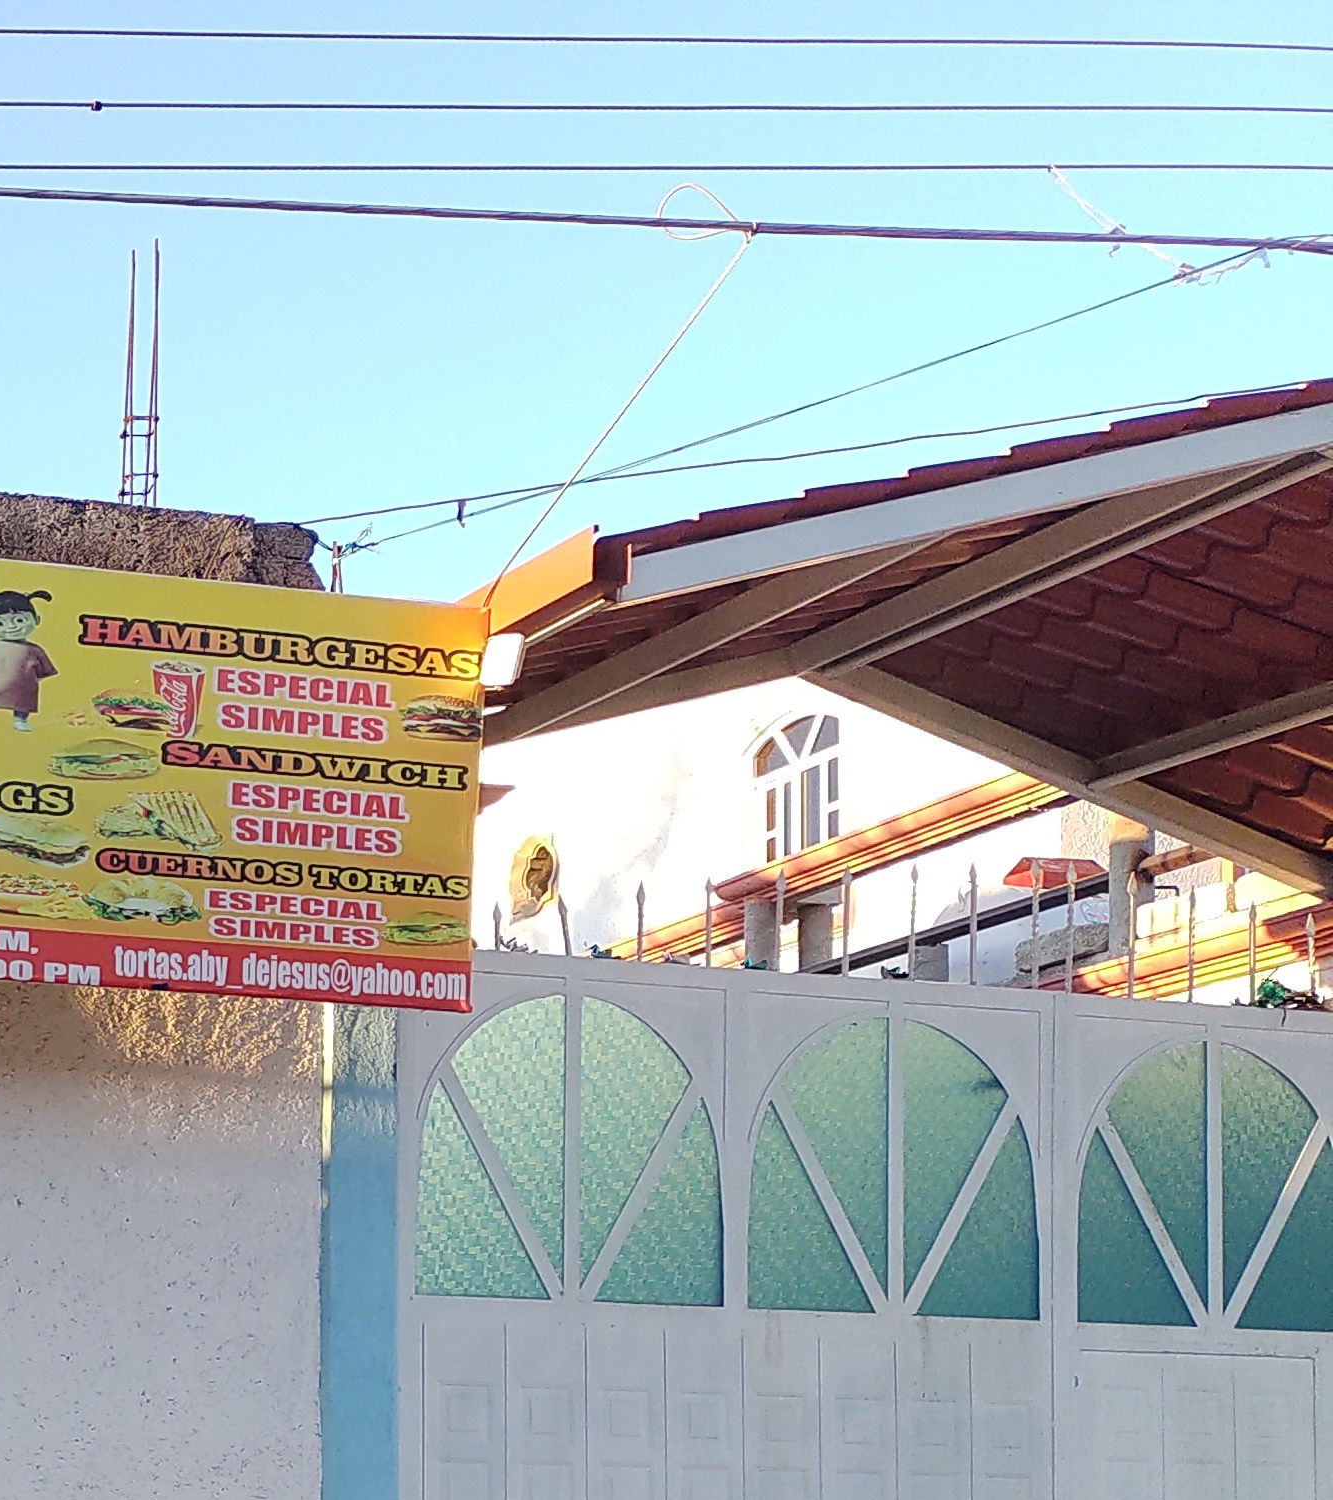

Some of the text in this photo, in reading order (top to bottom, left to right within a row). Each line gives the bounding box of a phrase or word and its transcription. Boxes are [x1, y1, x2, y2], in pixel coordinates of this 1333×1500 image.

[83, 617, 480, 679] HAMBURGESAS
[216, 668, 393, 708] ESPECIAL
[220, 704, 386, 743] SIMPLES
[165, 742, 465, 788] SANDWICH
[230, 782, 407, 821] ESPECIAL
[235, 817, 398, 854] SIMPLES
[98, 849, 470, 899] CUERNOS TORTAS
[206, 889, 384, 922] ESPECIAL
[212, 917, 376, 948] SIMPLES
[43, 962, 101, 986] PM
